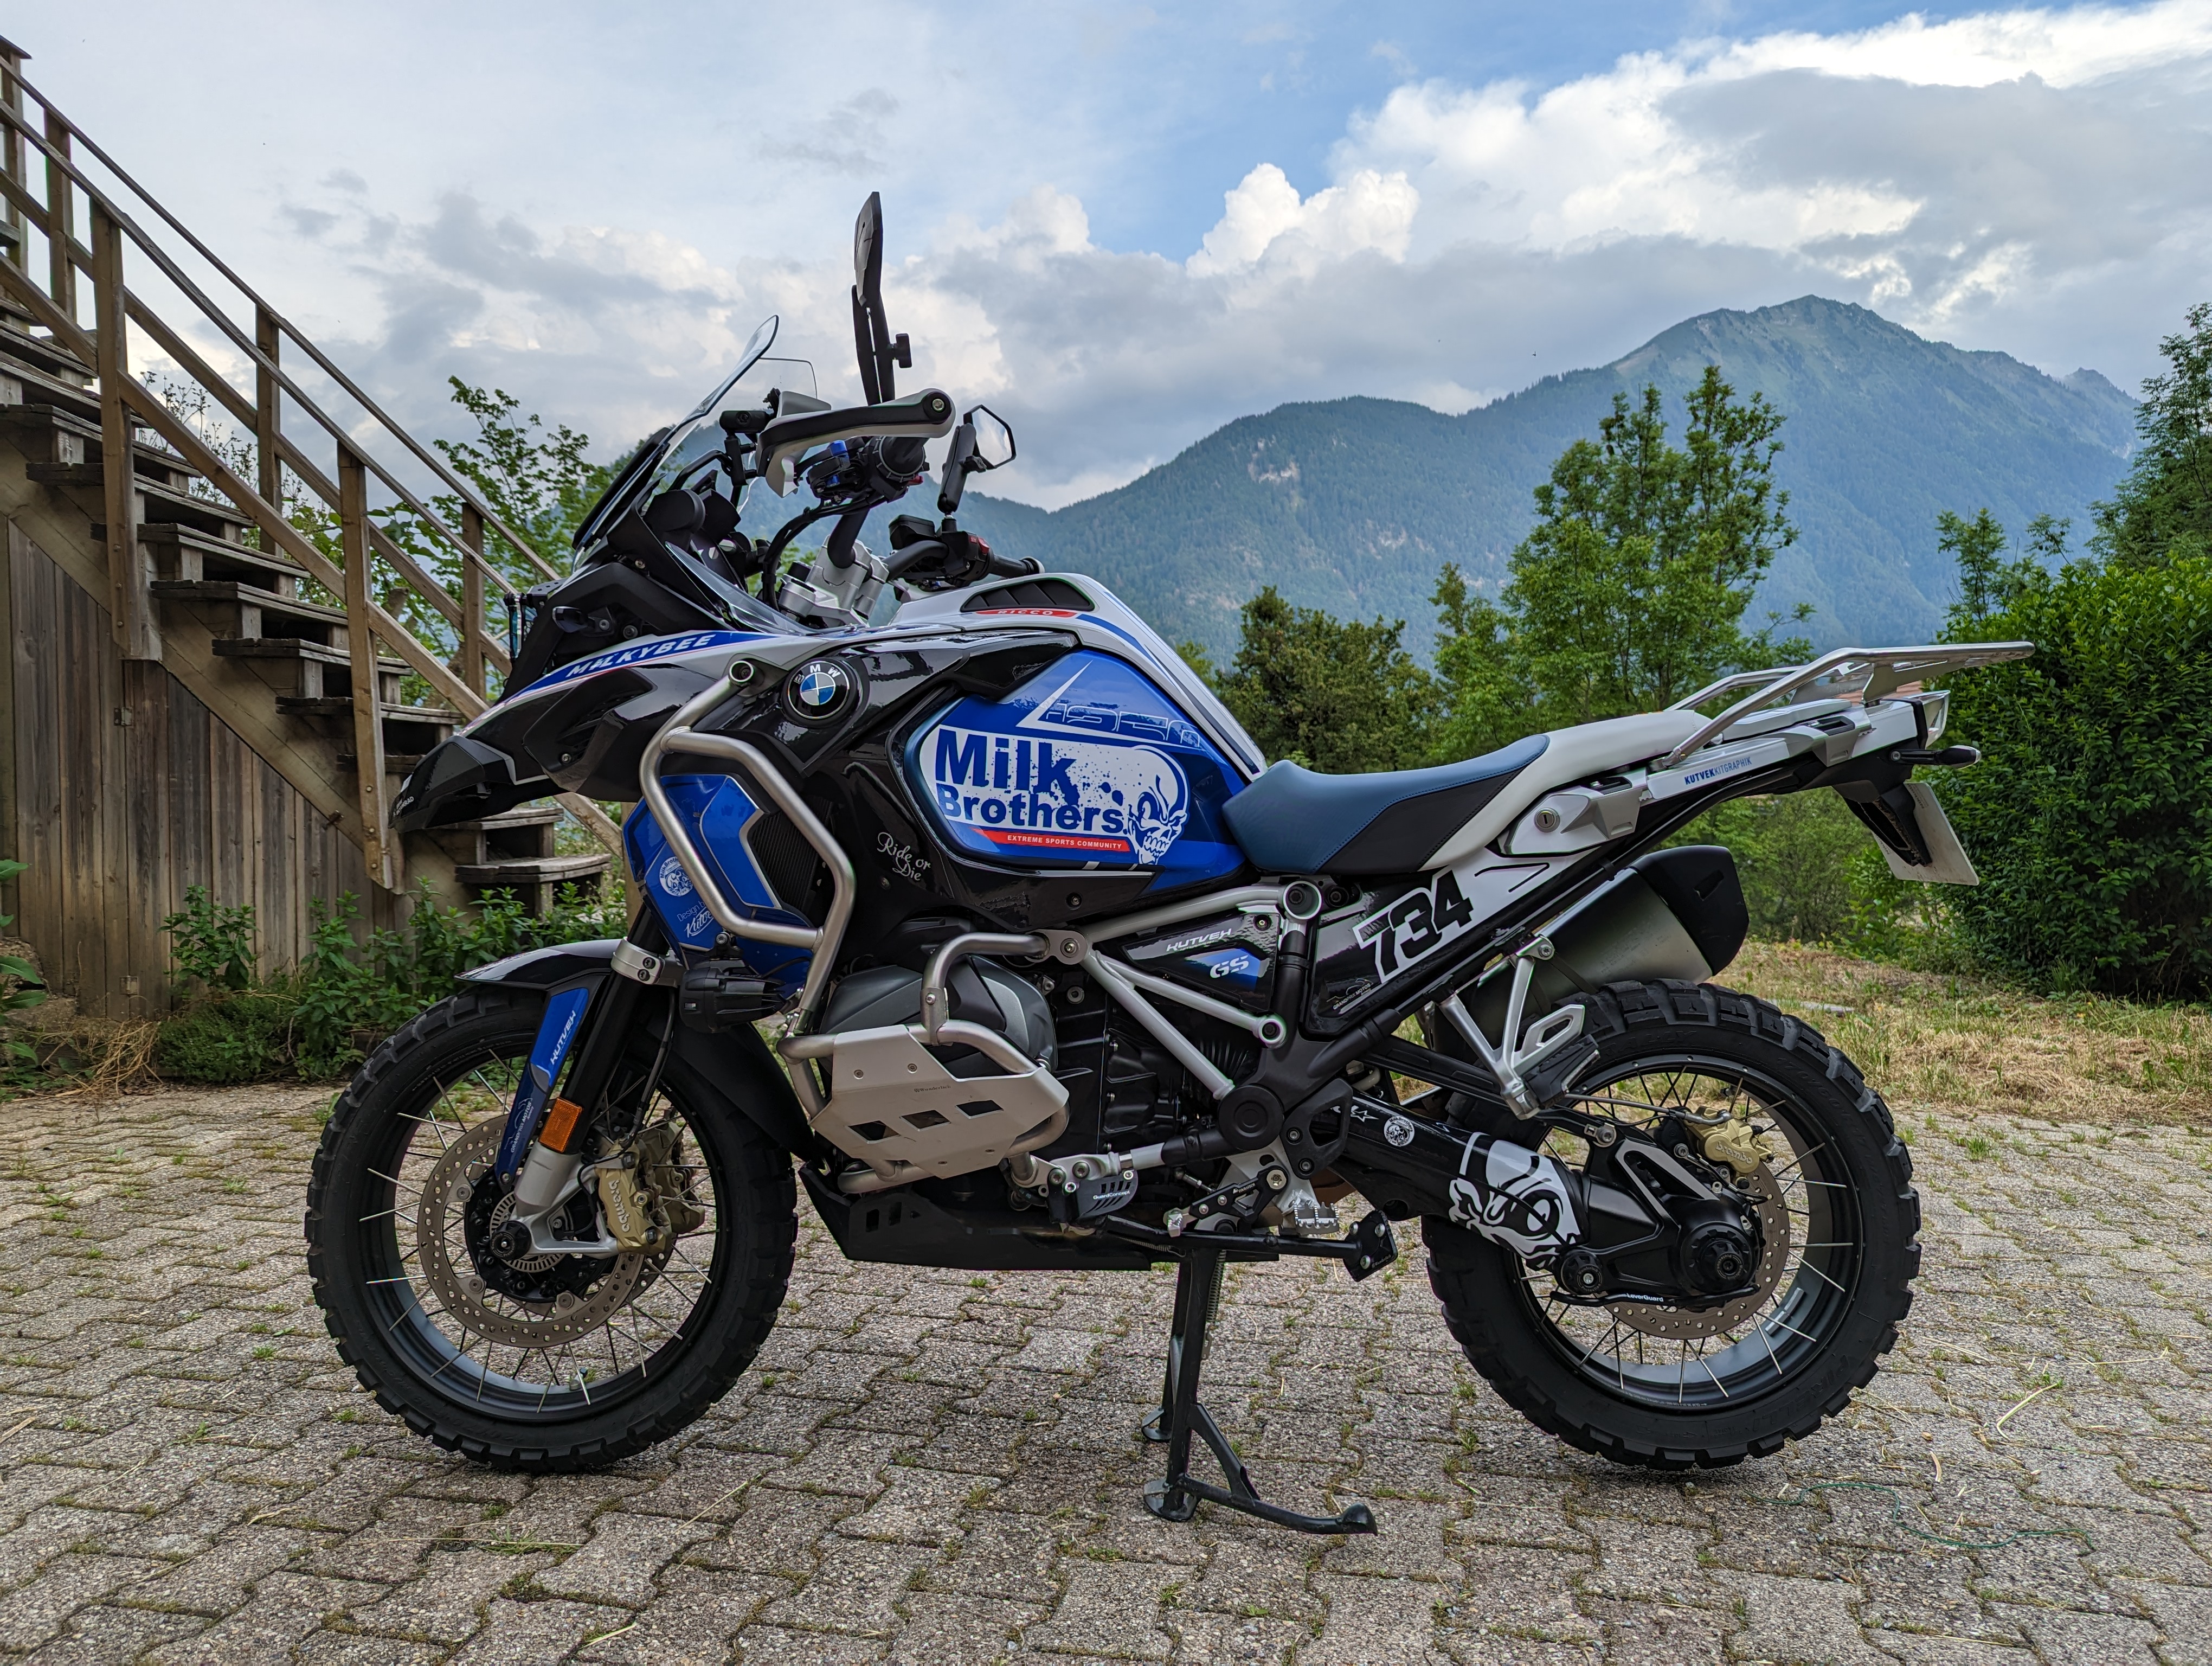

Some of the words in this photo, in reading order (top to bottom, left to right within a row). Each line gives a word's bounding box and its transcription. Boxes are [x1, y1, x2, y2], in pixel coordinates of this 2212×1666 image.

[793, 664, 841, 685] BMW
[935, 728, 1078, 798] Milk
[936, 783, 1125, 835] Brothers
[877, 831, 912, 862] Ride
[915, 858, 931, 870] or
[1007, 835, 1043, 843] EXTREME
[1077, 840, 1122, 849] COMMUNITY
[892, 856, 921, 881] Die
[677, 905, 699, 922] Design
[684, 910, 714, 938] Kutve
[1354, 869, 1475, 981] 734
[1210, 954, 1249, 978] GS
[1715, 1141, 1753, 1166] brembo
[608, 1179, 631, 1233] brembo
[1626, 1292, 1664, 1303] LeverGuard
